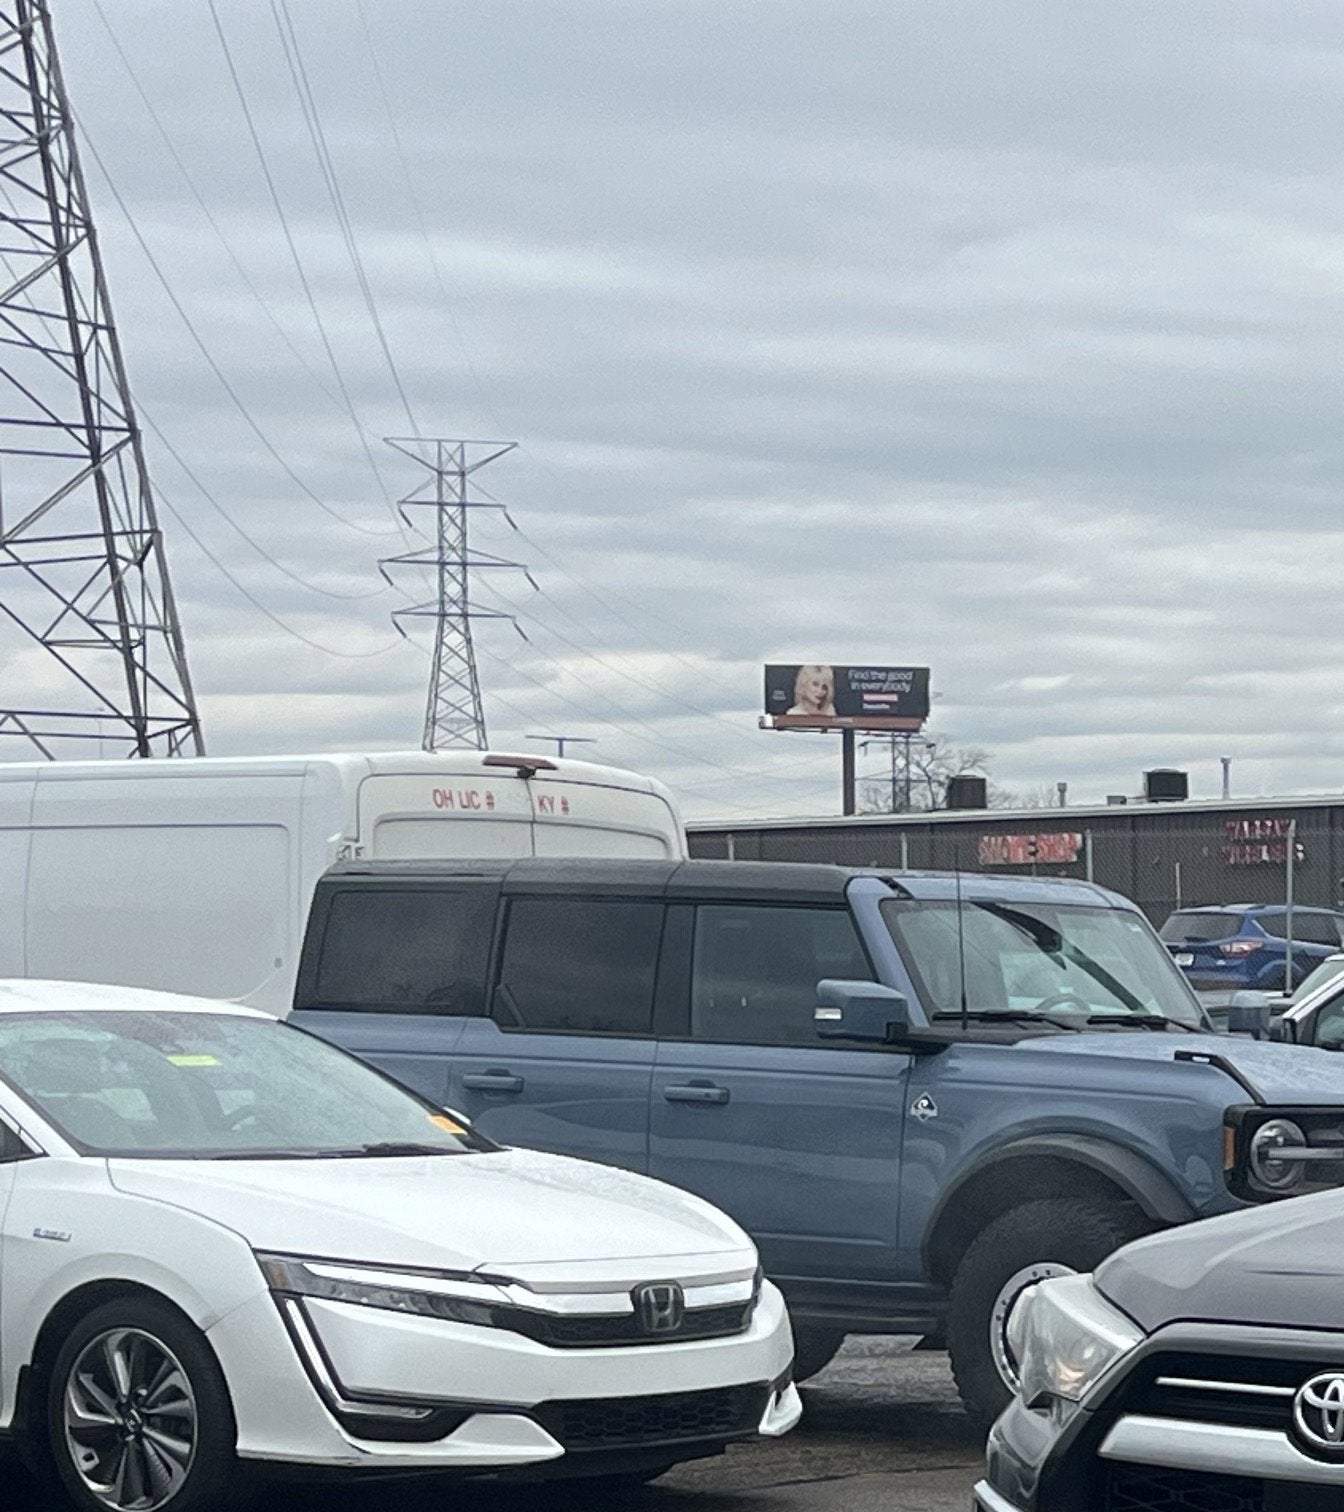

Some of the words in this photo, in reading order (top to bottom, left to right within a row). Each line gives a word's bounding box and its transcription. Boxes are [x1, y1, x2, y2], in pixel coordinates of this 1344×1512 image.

[432, 788, 454, 809] OH
[458, 790, 481, 810] LIC
[537, 795, 554, 813] KY
